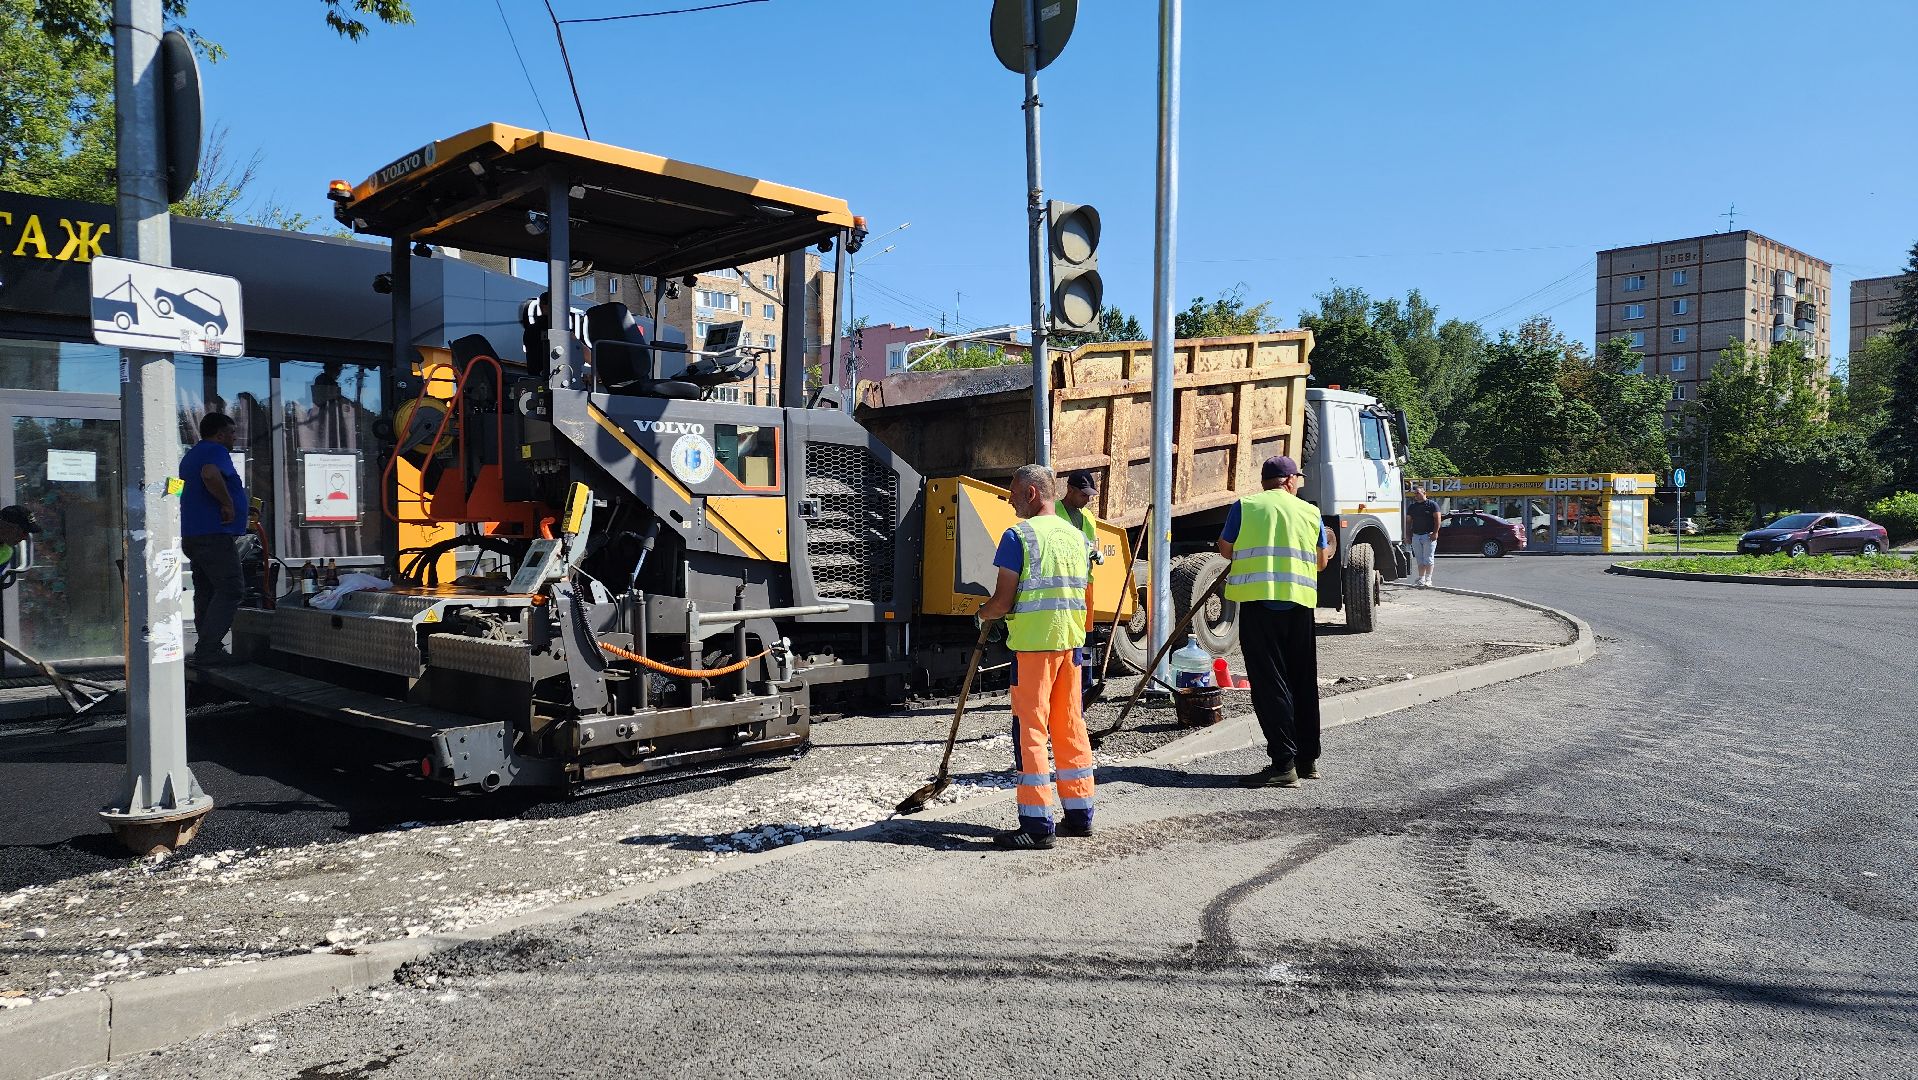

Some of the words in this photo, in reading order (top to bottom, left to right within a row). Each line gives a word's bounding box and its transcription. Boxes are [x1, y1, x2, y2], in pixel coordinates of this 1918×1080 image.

[380, 154, 420, 182] VOLVO
[633, 419, 705, 435] VOLVO
[1545, 477, 1604, 491] ЦВЕТЫ
